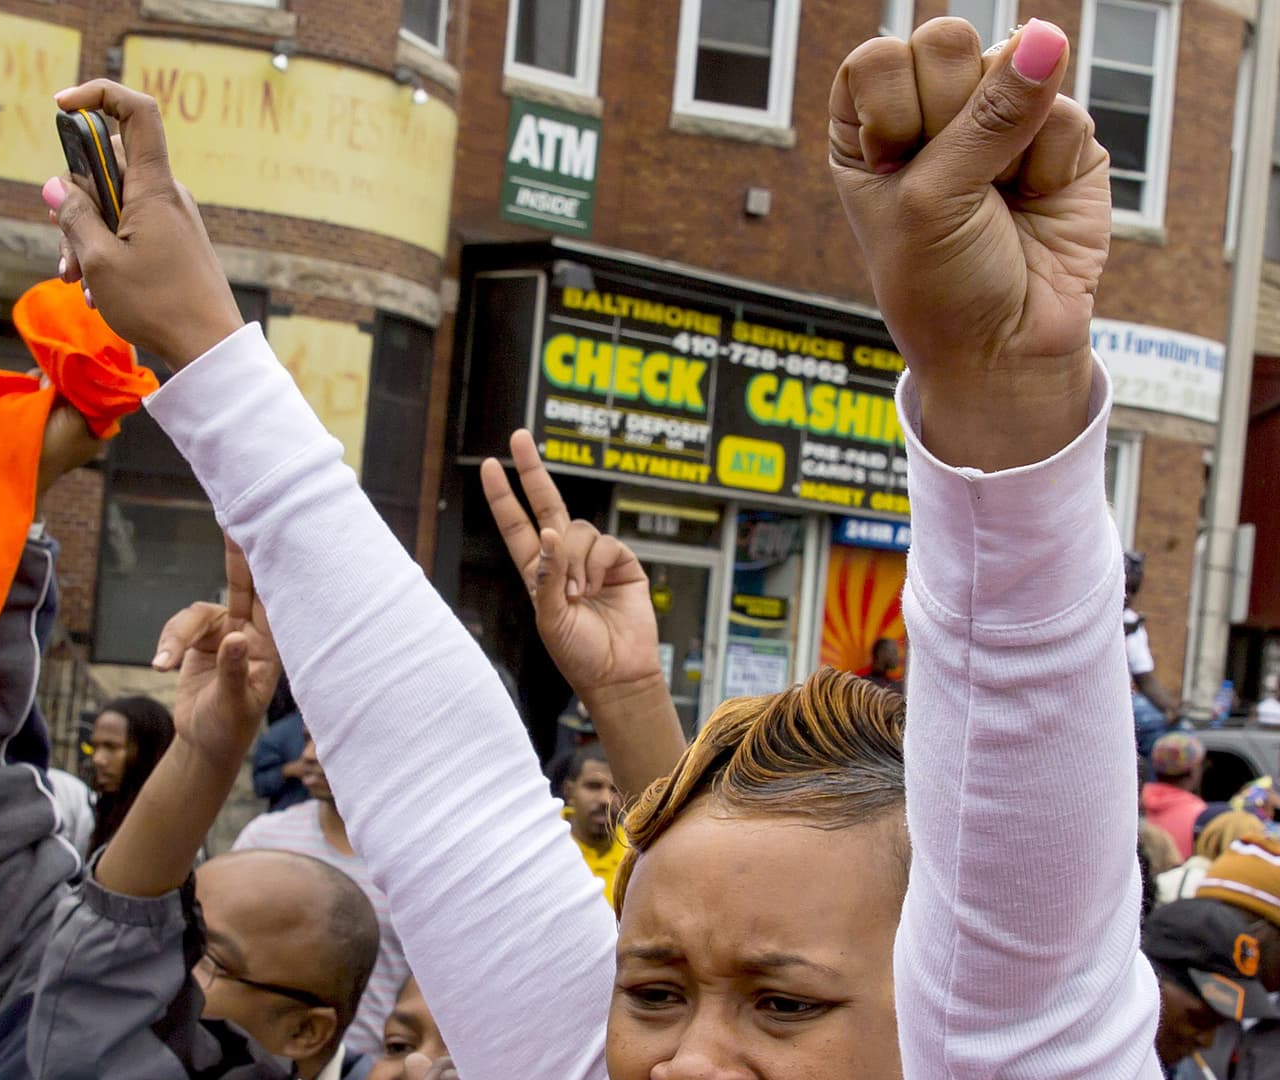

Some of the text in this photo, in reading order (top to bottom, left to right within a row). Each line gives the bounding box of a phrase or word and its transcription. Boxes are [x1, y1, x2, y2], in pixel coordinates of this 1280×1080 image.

[508, 113, 599, 182] ATM
[515, 187, 581, 219] INSIDE
[562, 286, 722, 337] BALTIMORE
[731, 320, 845, 362] SERVICE
[542, 332, 708, 415] CHECK
[543, 396, 625, 430] DIRECT
[624, 412, 712, 444] DEPOSIT
[544, 437, 595, 467] BILL
[602, 448, 713, 485] PAYMENT
[729, 450, 777, 478] ATM
[800, 458, 868, 485] CARDS
[801, 439, 889, 471] PRE-PAID
[799, 479, 867, 508] MONEY
